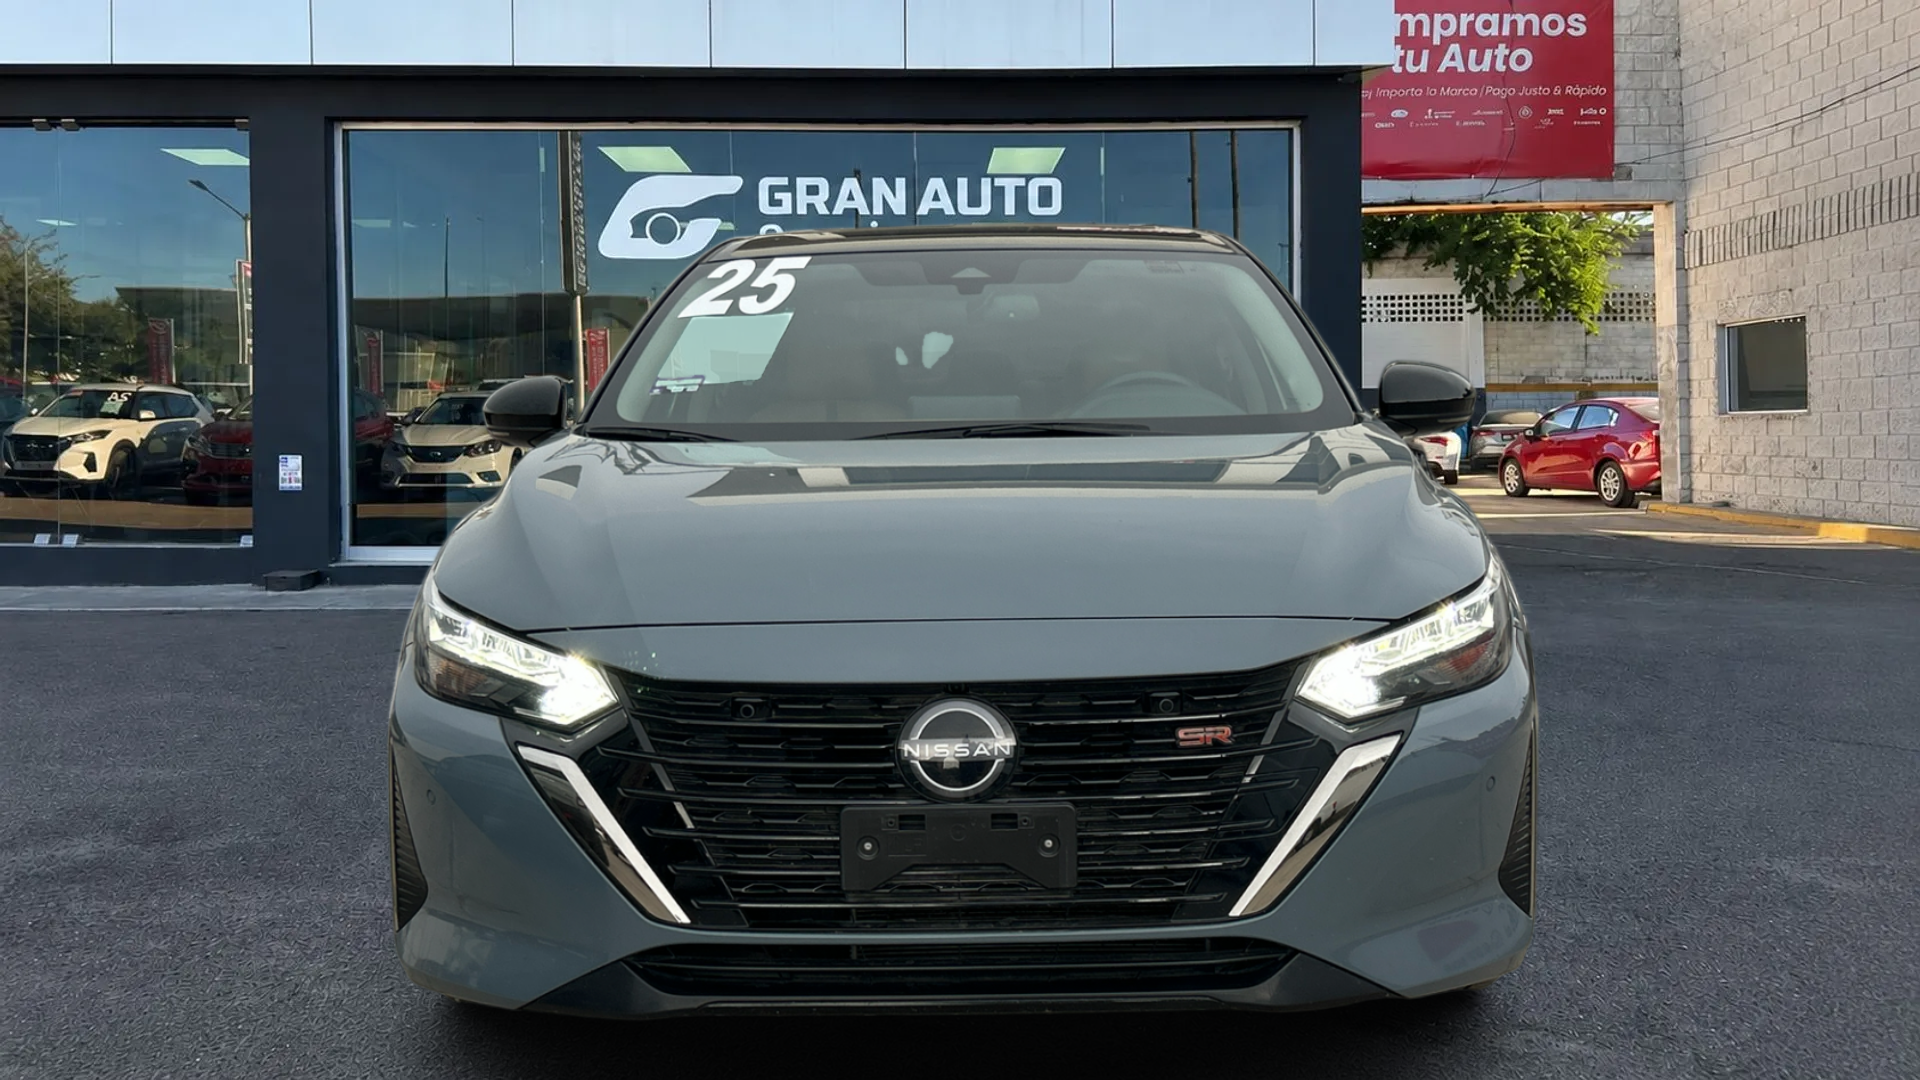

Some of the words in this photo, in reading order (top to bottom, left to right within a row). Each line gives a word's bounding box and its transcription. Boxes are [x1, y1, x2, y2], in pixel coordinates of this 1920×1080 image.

[1392, 43, 1430, 73] tu
[1437, 43, 1534, 73] Auto
[1519, 85, 1551, 96] Justo
[1553, 85, 1562, 96] &
[758, 176, 906, 216] GRAN
[916, 176, 1062, 216] AUTO
[677, 256, 813, 318] 25
[1178, 726, 1232, 747] SR
[904, 742, 1011, 758] NISSAN
